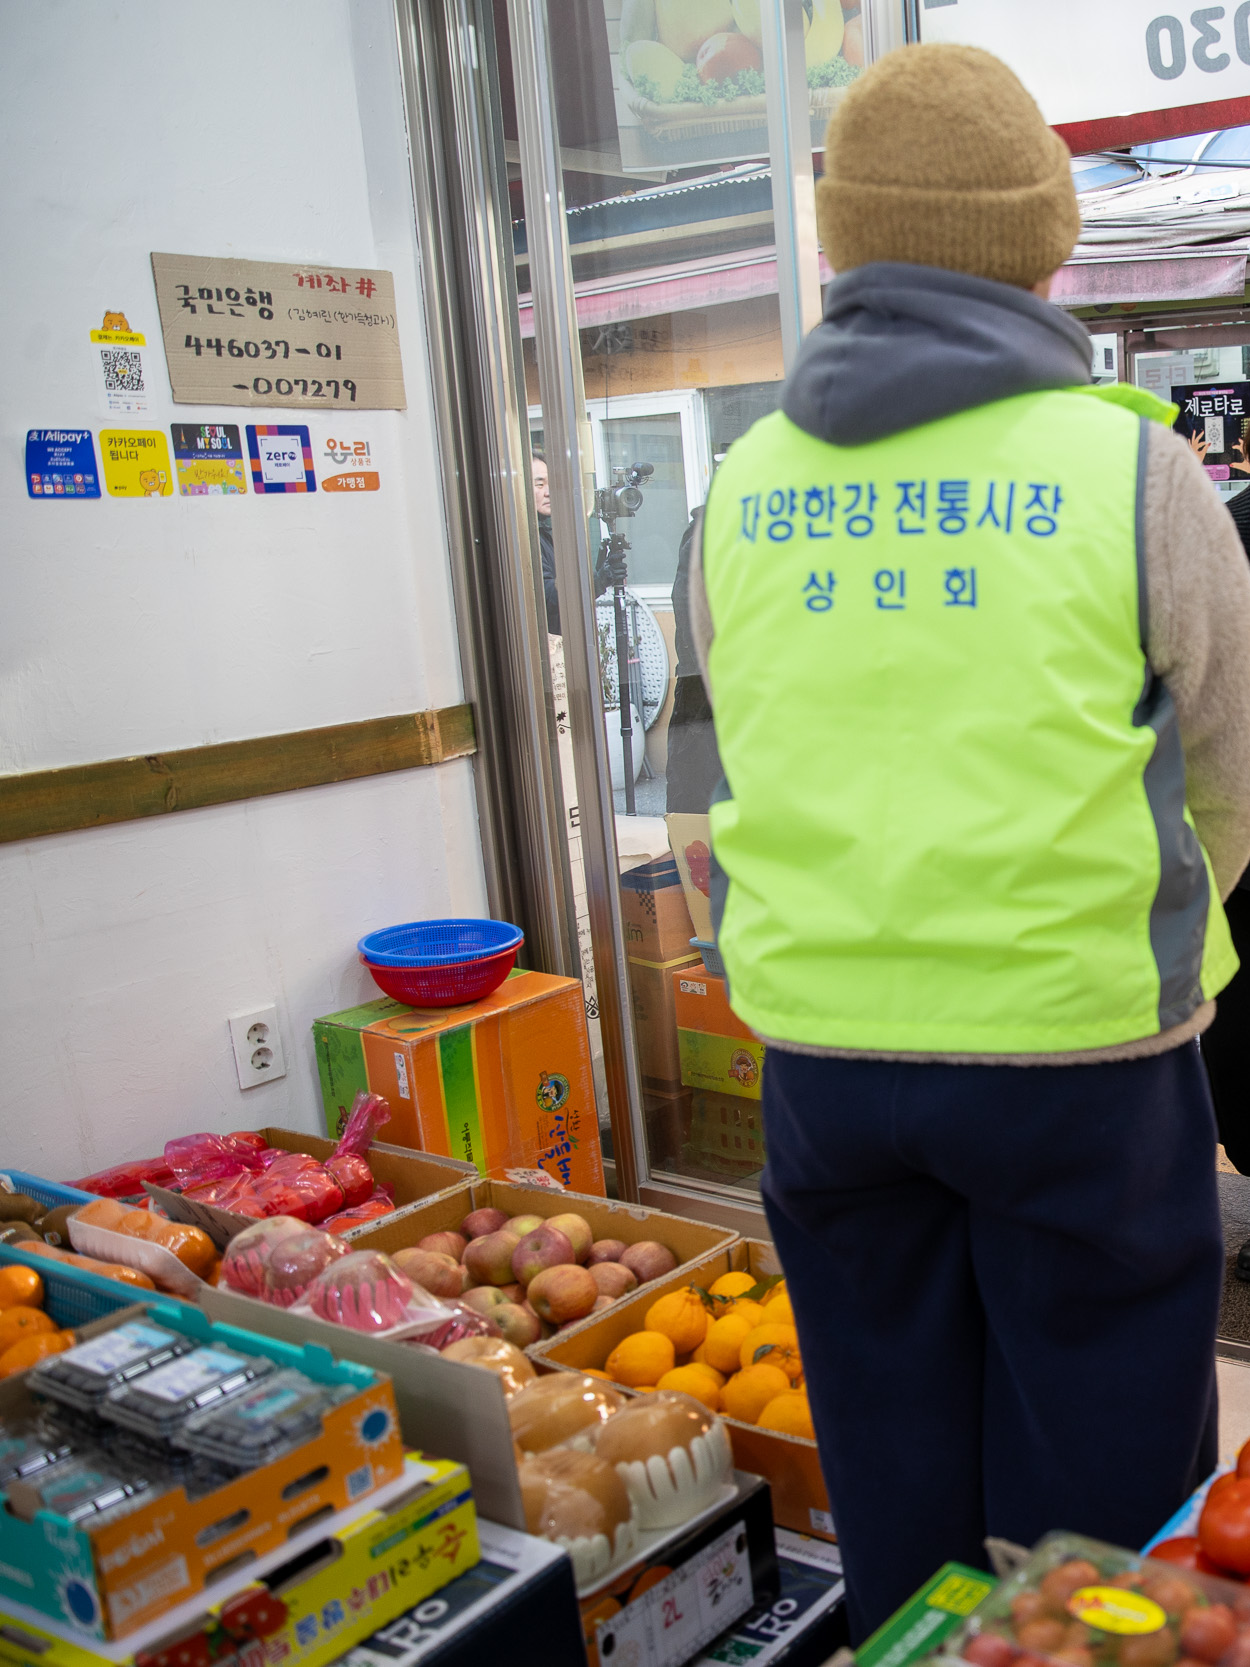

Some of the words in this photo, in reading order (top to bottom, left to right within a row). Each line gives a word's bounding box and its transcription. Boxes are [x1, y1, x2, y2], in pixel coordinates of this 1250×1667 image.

[292, 273, 351, 294] 계좌
[175, 284, 274, 320] 국민은행
[185, 335, 342, 361] 446037-01
[232, 377, 357, 402] -007279
[1184, 395, 1246, 417] 제로타로
[200, 425, 227, 438] SEOUL
[107, 437, 156, 449] 카카오페이
[211, 438, 232, 449] SOUL
[109, 450, 139, 461] 됩니다
[351, 458, 372, 466] 상품권
[337, 477, 366, 488] 가맹점
[894, 480, 1064, 537] 전통시장
[802, 570, 838, 613] 상
[873, 568, 907, 611] 인
[944, 566, 978, 609] 회
[537, 1115, 572, 1185] 산들배
